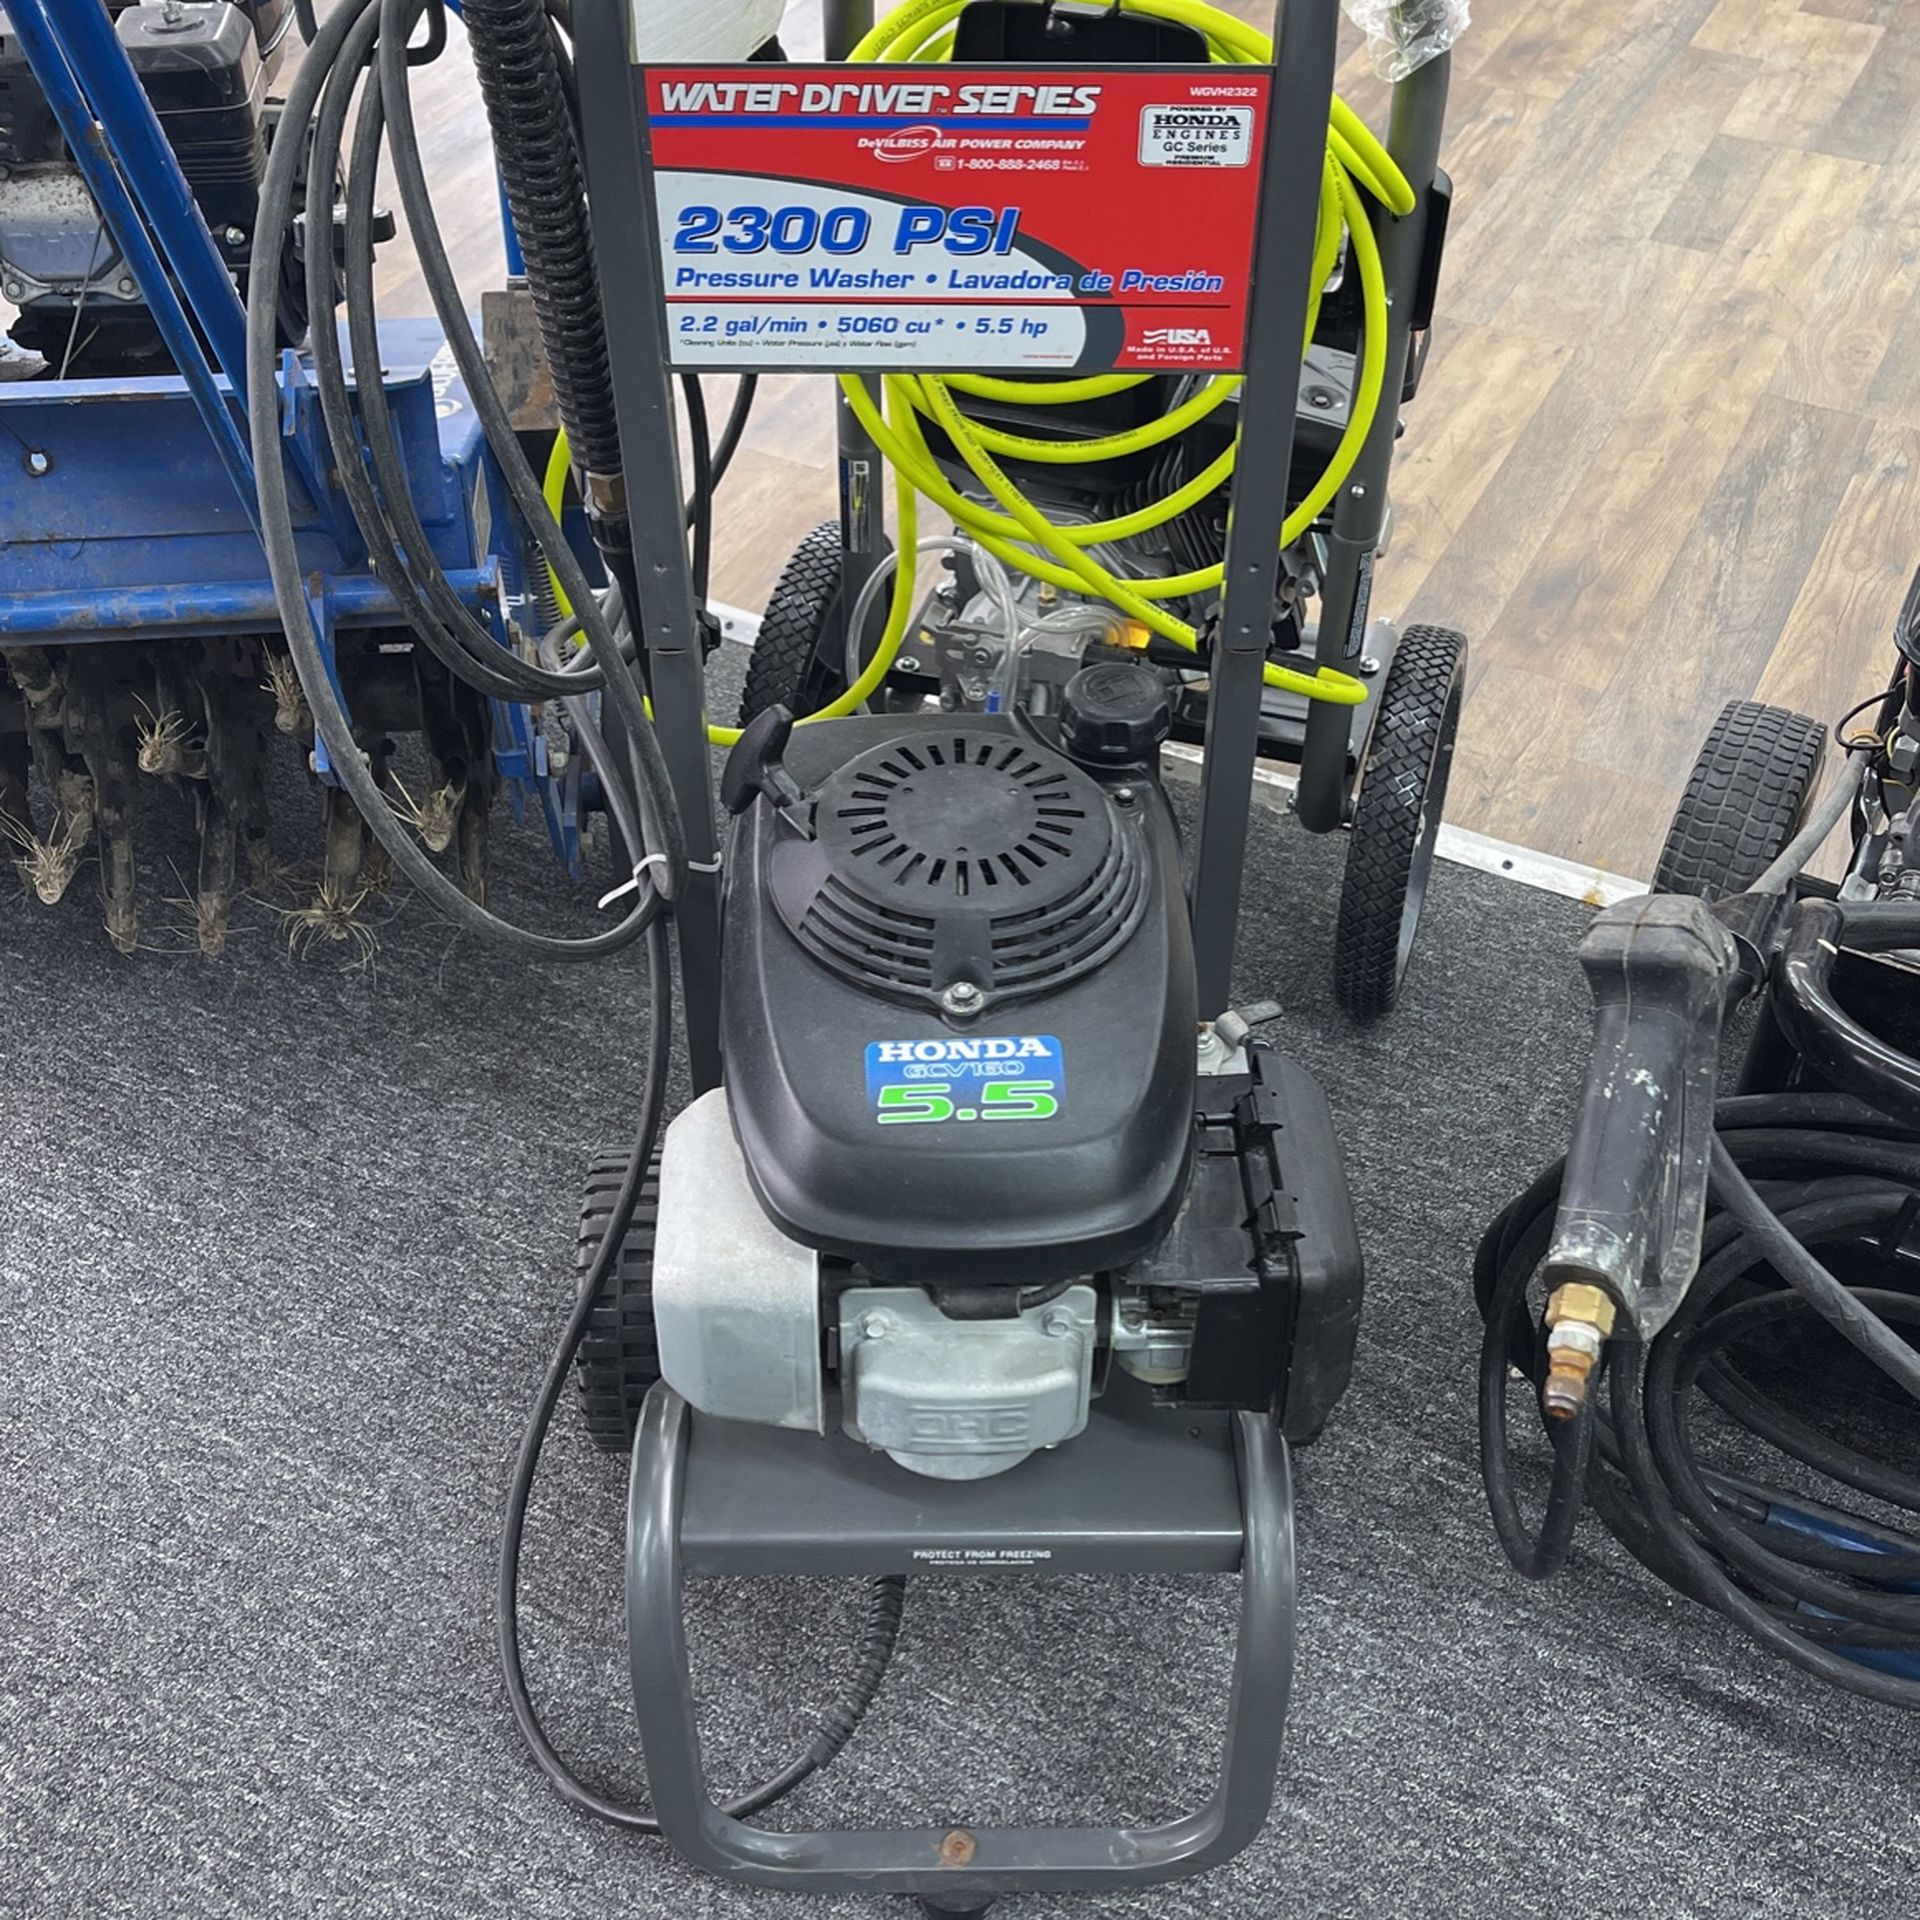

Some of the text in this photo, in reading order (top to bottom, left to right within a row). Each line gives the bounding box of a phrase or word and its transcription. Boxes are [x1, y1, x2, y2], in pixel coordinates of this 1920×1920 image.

[1189, 86, 1258, 97] WGVH2322
[661, 83, 798, 112] WATER
[800, 84, 950, 113] DRIVER
[953, 85, 1102, 115] SERIES
[1153, 114, 1241, 126] HONDA
[1152, 129, 1241, 140] ENGINES
[931, 138, 957, 149] AIR
[959, 138, 1013, 149] POWER
[1014, 138, 1087, 150] COMPANY
[1162, 141, 1227, 153] GC Series
[957, 158, 1061, 170] 1-800-888-2468
[673, 205, 1021, 256] 2300 PSI
[675, 266, 1223, 292] Pressure Washer Lavadora de Presión
[679, 315, 718, 333] 2.2
[725, 315, 808, 337] gal/min
[836, 316, 899, 334] 5060
[974, 317, 1014, 335] 5.5
[1019, 318, 1048, 338] hp
[1167, 328, 1212, 345] USA
[1157, 354, 1195, 362] Foreign
[878, 1037, 1053, 1063] HONDA
[903, 1060, 1026, 1079] GCV160
[877, 1080, 1059, 1125] 5.5
[913, 1550, 1052, 1559] PROTECT FROM FREEZING
